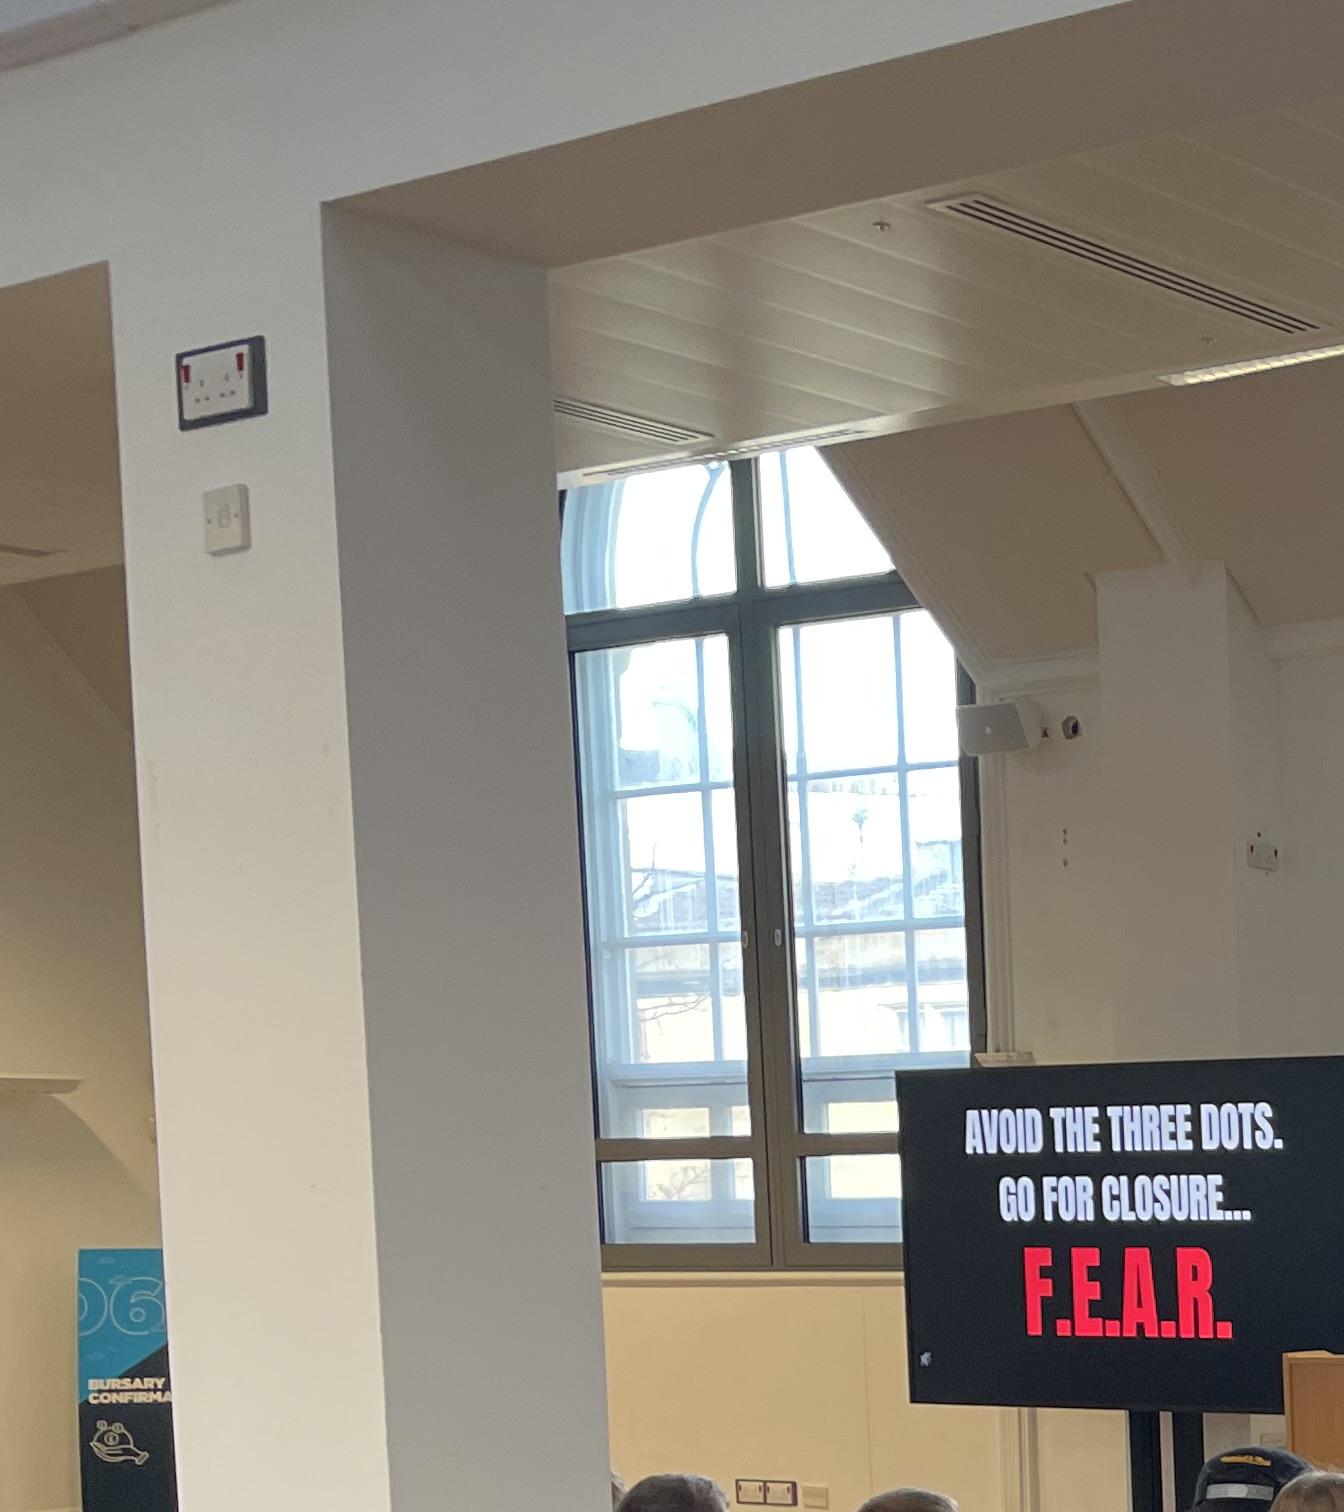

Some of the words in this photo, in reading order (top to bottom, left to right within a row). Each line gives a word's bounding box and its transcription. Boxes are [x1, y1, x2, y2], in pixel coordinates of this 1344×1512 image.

[965, 1107, 1044, 1155] AVOID
[1049, 1106, 1102, 1153] THE
[1106, 1103, 1194, 1153] THREE
[1200, 1101, 1284, 1151] DOTS.
[998, 1175, 1036, 1222] GO
[1042, 1175, 1095, 1222] FOR
[1101, 1174, 1252, 1222] CLOSURE...
[1022, 1247, 1234, 1340] F.E.A.R.
[88, 1378, 165, 1390] BURSARY
